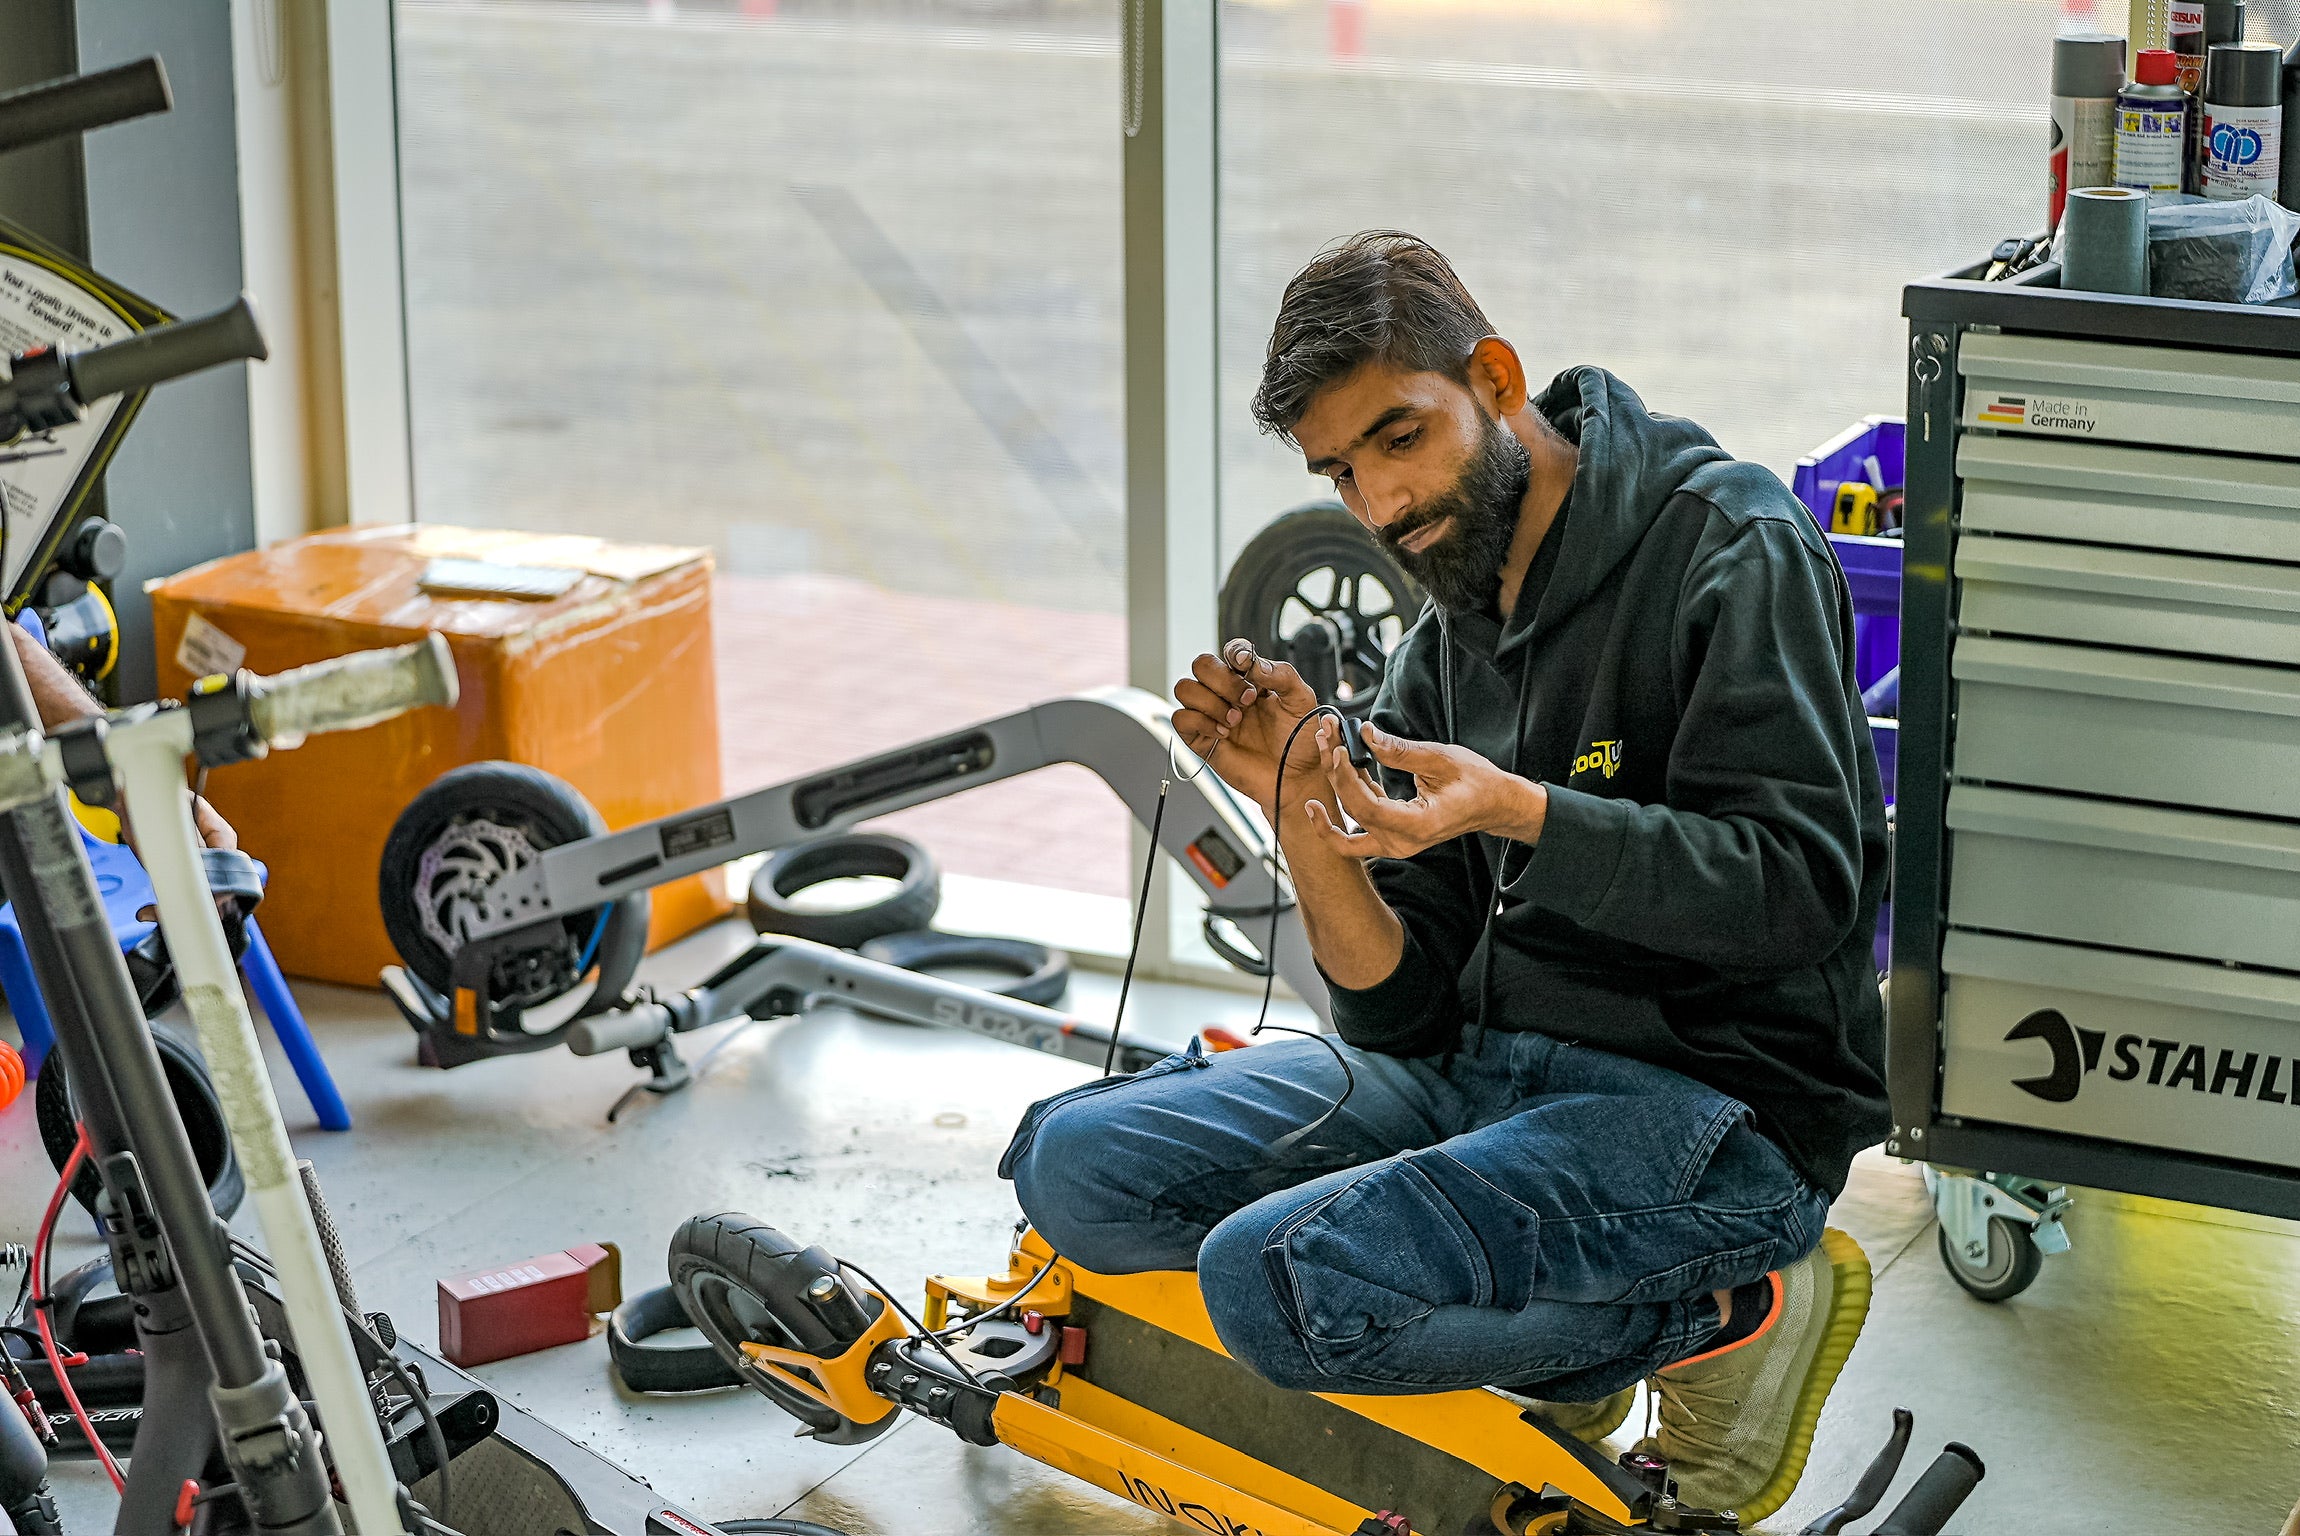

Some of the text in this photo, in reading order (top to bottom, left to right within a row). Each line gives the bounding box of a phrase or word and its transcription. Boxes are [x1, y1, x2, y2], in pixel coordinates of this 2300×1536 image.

[4, 269, 24, 289] Your
[2032, 399, 2088, 416] Made in
[2031, 414, 2096, 433] Germany
[1117, 1469, 1264, 1536] INOK
